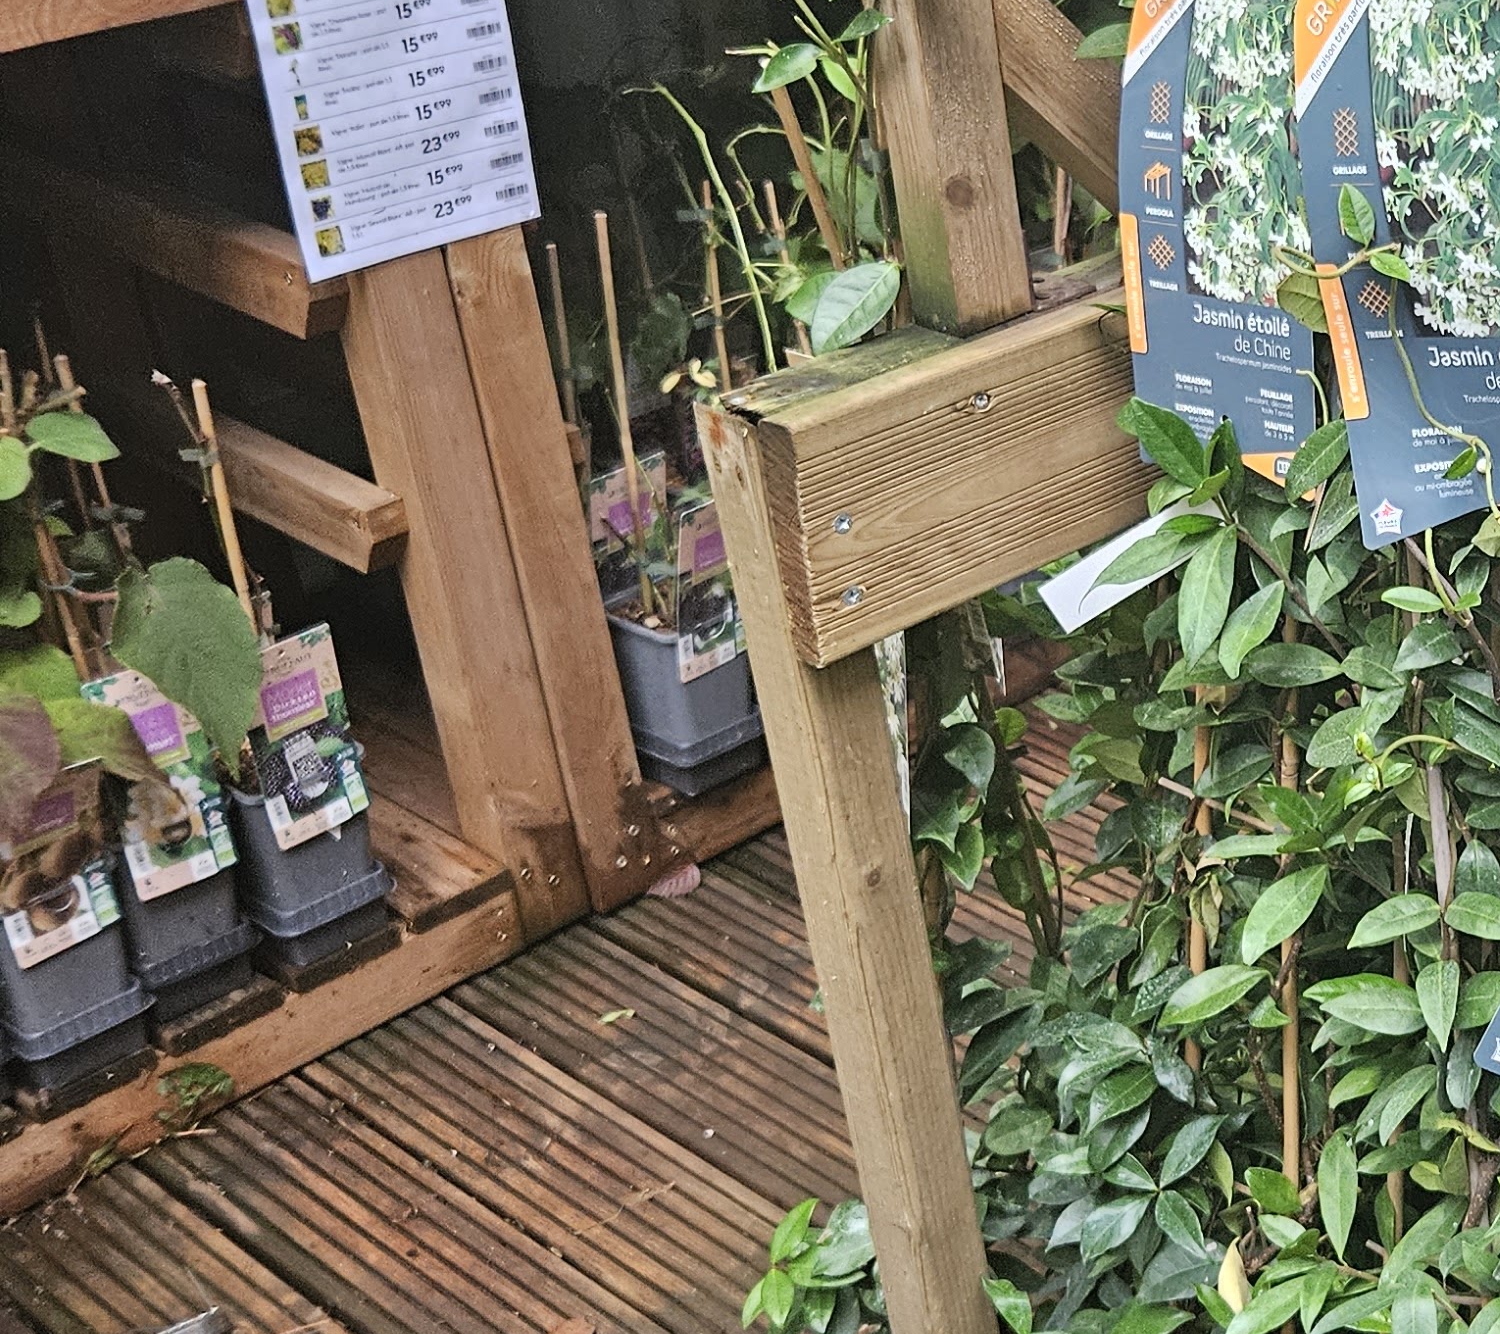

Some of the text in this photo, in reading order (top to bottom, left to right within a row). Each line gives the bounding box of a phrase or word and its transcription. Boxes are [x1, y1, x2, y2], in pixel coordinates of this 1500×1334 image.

[1310, 38, 1339, 84] floraison
[1335, 19, 1351, 42] très
[1332, 164, 1368, 176] GRILLAGE
[1193, 304, 1291, 338] Jasmin étoilé
[1234, 337, 1292, 361] de Chine
[1429, 346, 1495, 368] Jasmin
[1175, 373, 1212, 388] FLORAISON
[1175, 402, 1215, 418] EXPOSITION
[1264, 420, 1295, 434] HAUTEUR
